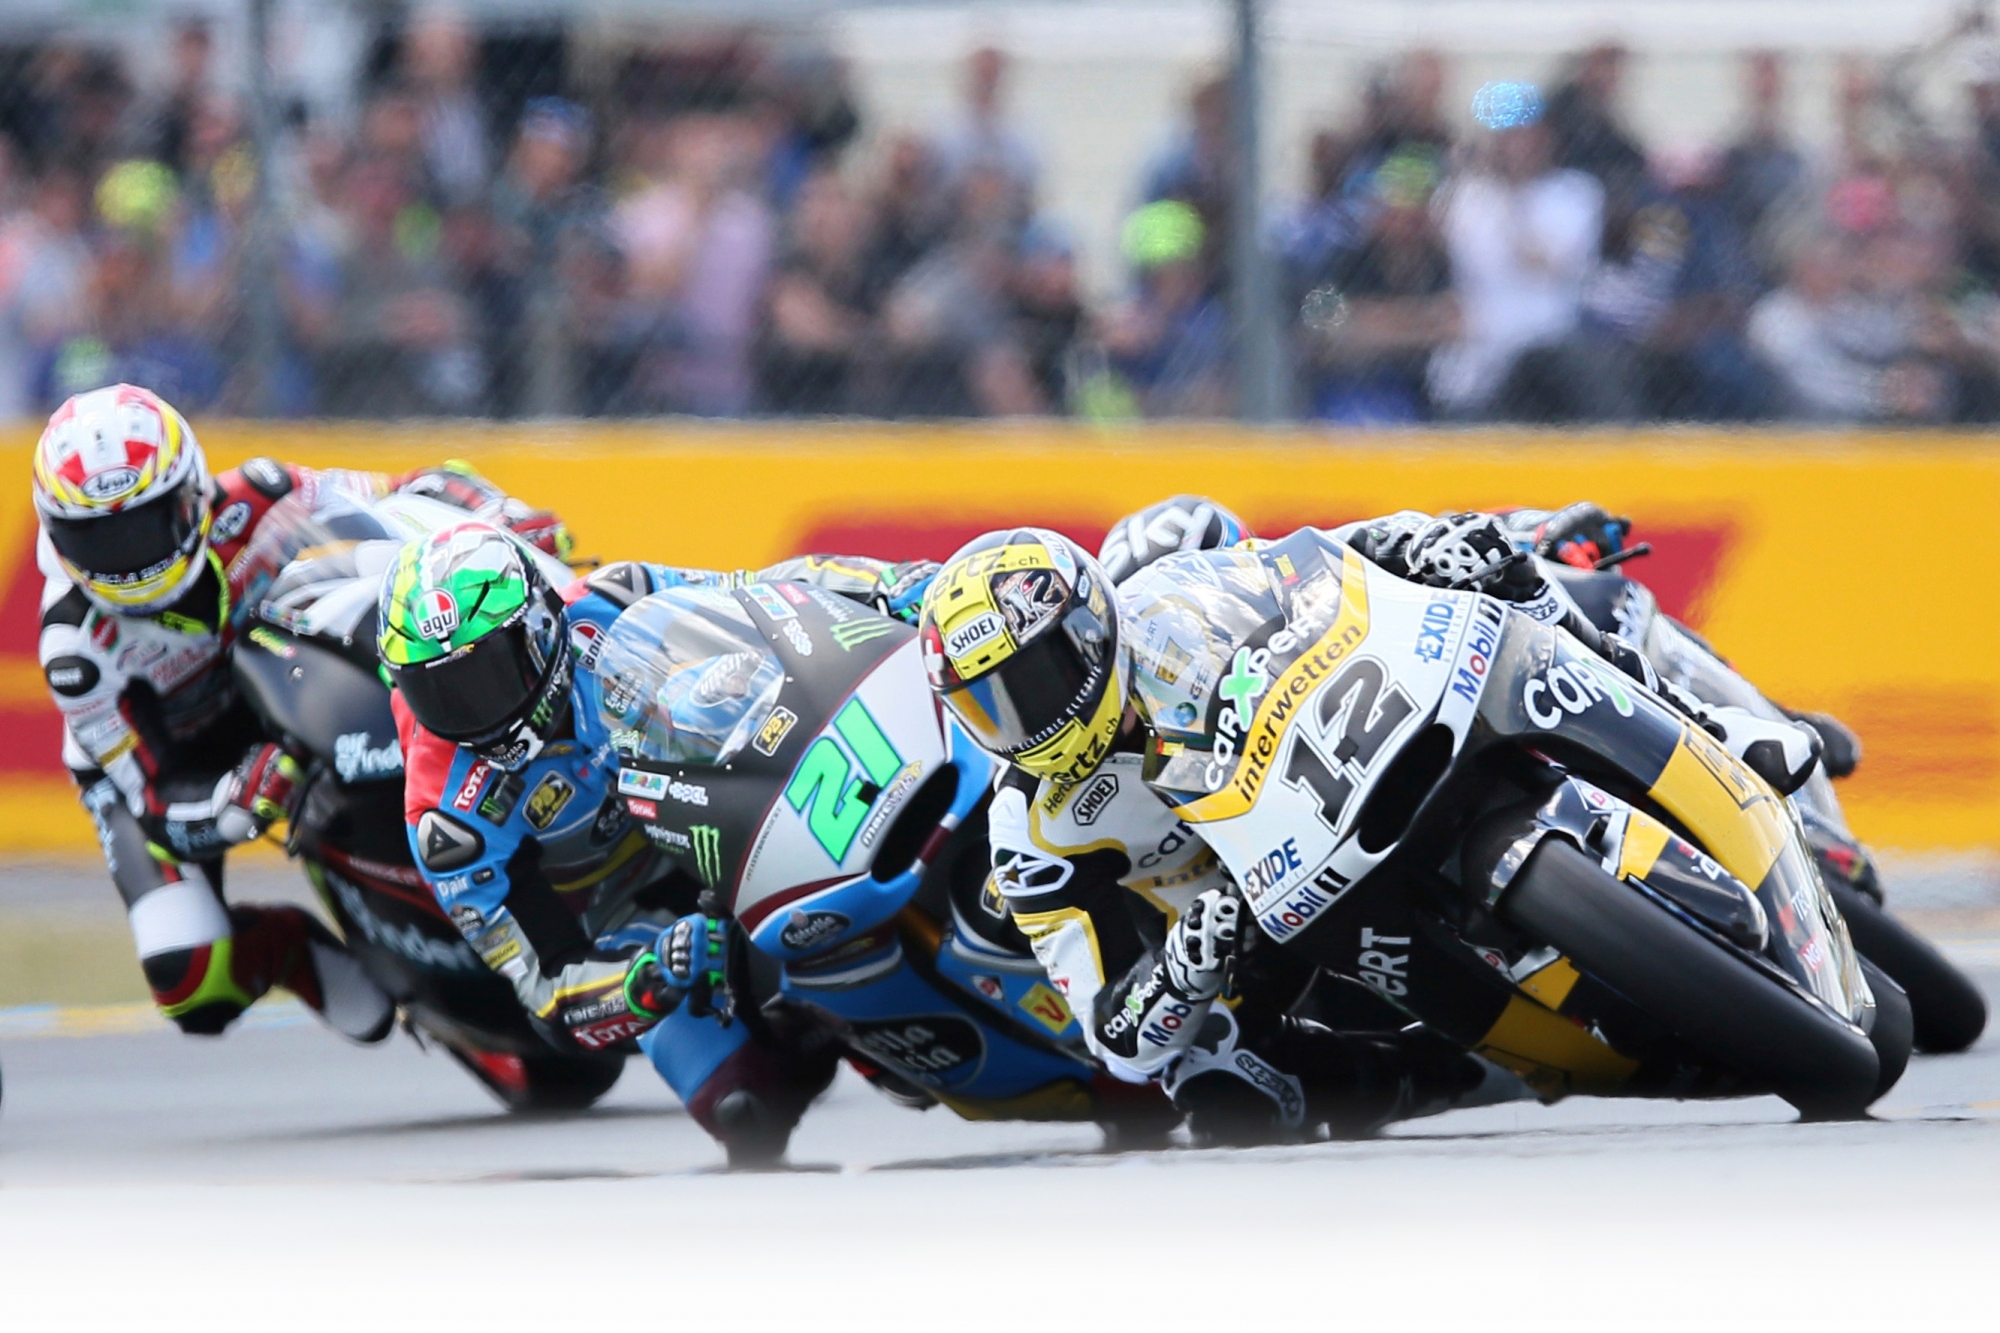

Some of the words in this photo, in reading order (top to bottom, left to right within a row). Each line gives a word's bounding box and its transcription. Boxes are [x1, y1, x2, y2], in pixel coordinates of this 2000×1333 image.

[422, 612, 454, 634] agv
[951, 616, 996, 653] SHOEI
[1414, 590, 1460, 663] EXIDE
[1452, 619, 1497, 704] Mobil
[1066, 665, 1102, 716] ELECTRIC
[1235, 623, 1362, 804] interwetten
[1018, 717, 1065, 751] ELECTRIC
[1281, 656, 1418, 833] 12
[453, 765, 490, 807] TOTA
[783, 695, 904, 868] 21
[1077, 778, 1115, 822] SHOEI
[1243, 836, 1302, 901] EXIDE
[1261, 886, 1329, 938] Mobil
[575, 1021, 647, 1047] TOTA
[1142, 1002, 1193, 1048] Mob
